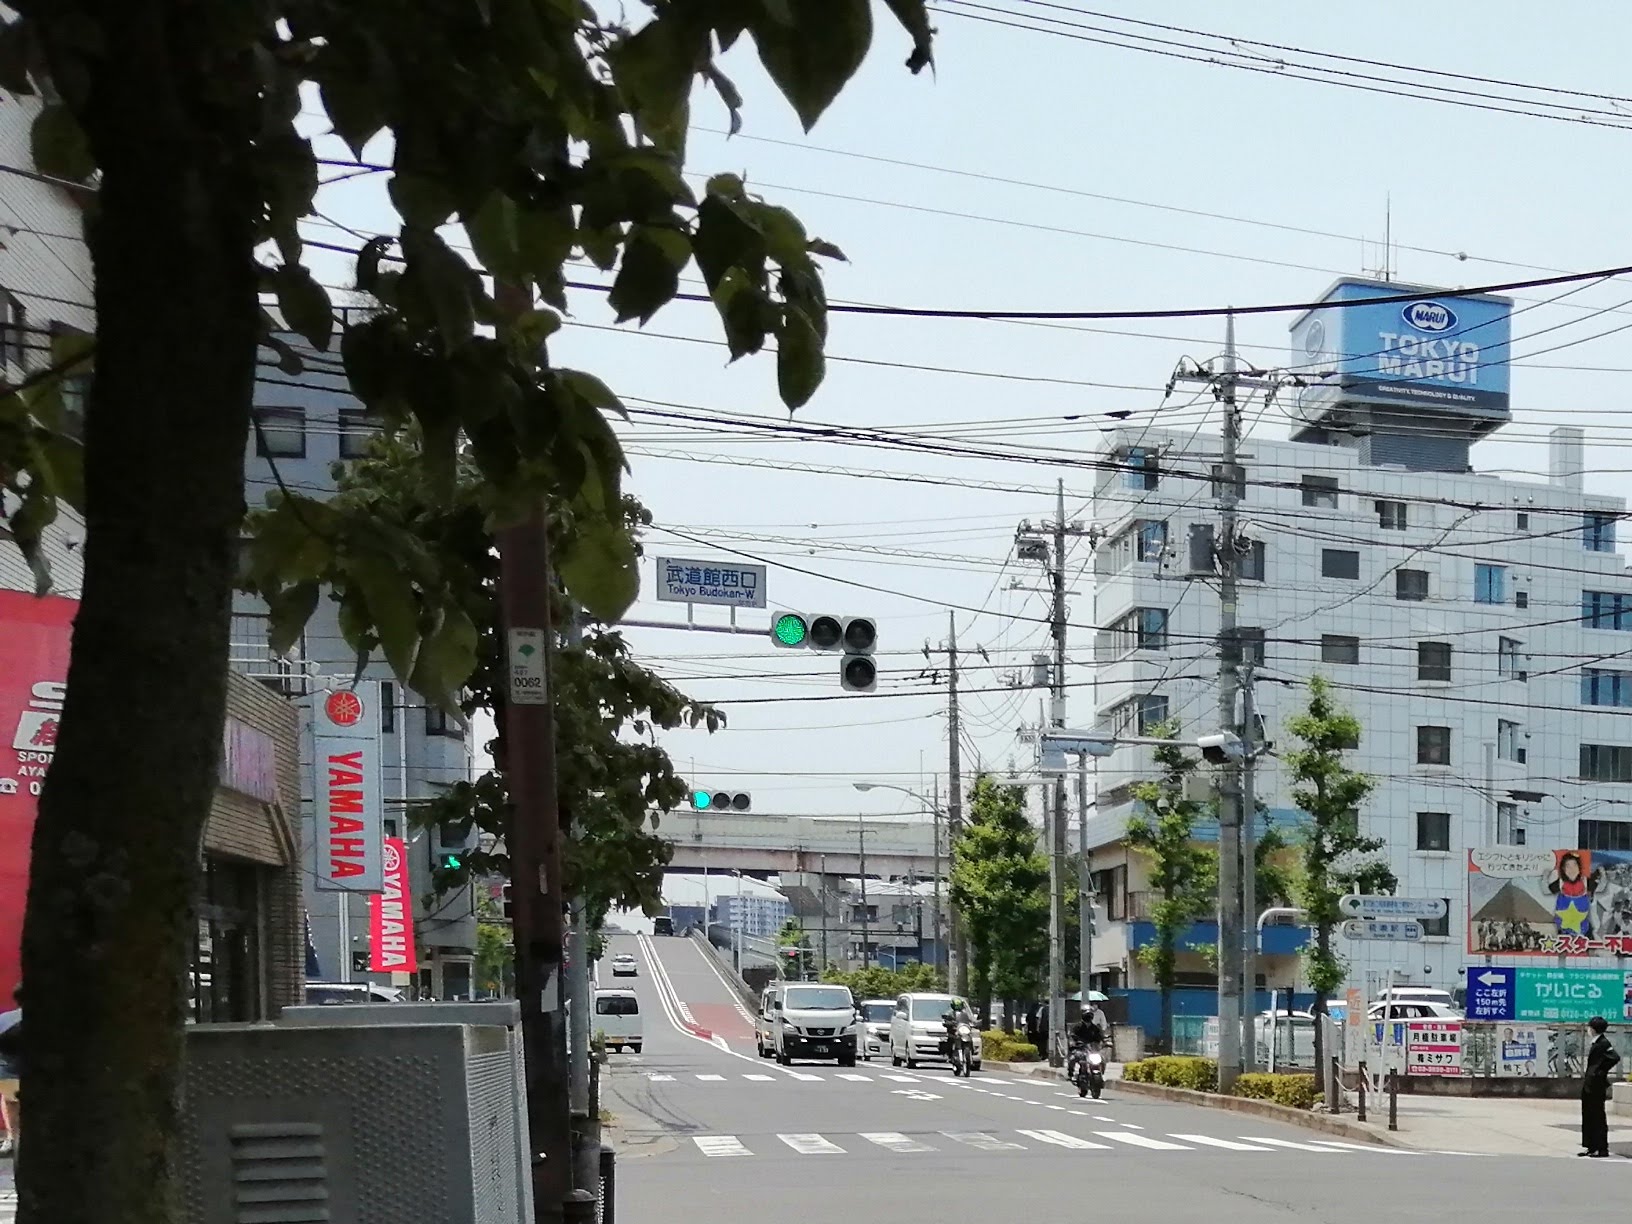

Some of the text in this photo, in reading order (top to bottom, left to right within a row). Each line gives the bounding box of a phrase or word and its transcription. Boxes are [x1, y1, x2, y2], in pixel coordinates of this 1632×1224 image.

[1414, 309, 1446, 323] MARUI
[1379, 331, 1480, 363] TOKYO
[1378, 353, 1479, 385] MARUI
[1410, 389, 1447, 399] TECHNOLOGY
[666, 565, 757, 588] 武道館西口
[667, 584, 696, 596] Tokyo
[328, 751, 365, 878] YAMAHA
[381, 872, 406, 968] YAMAHA
[1475, 989, 1507, 997] ここ左折
[1475, 1007, 1507, 1015] 左折すぐ
